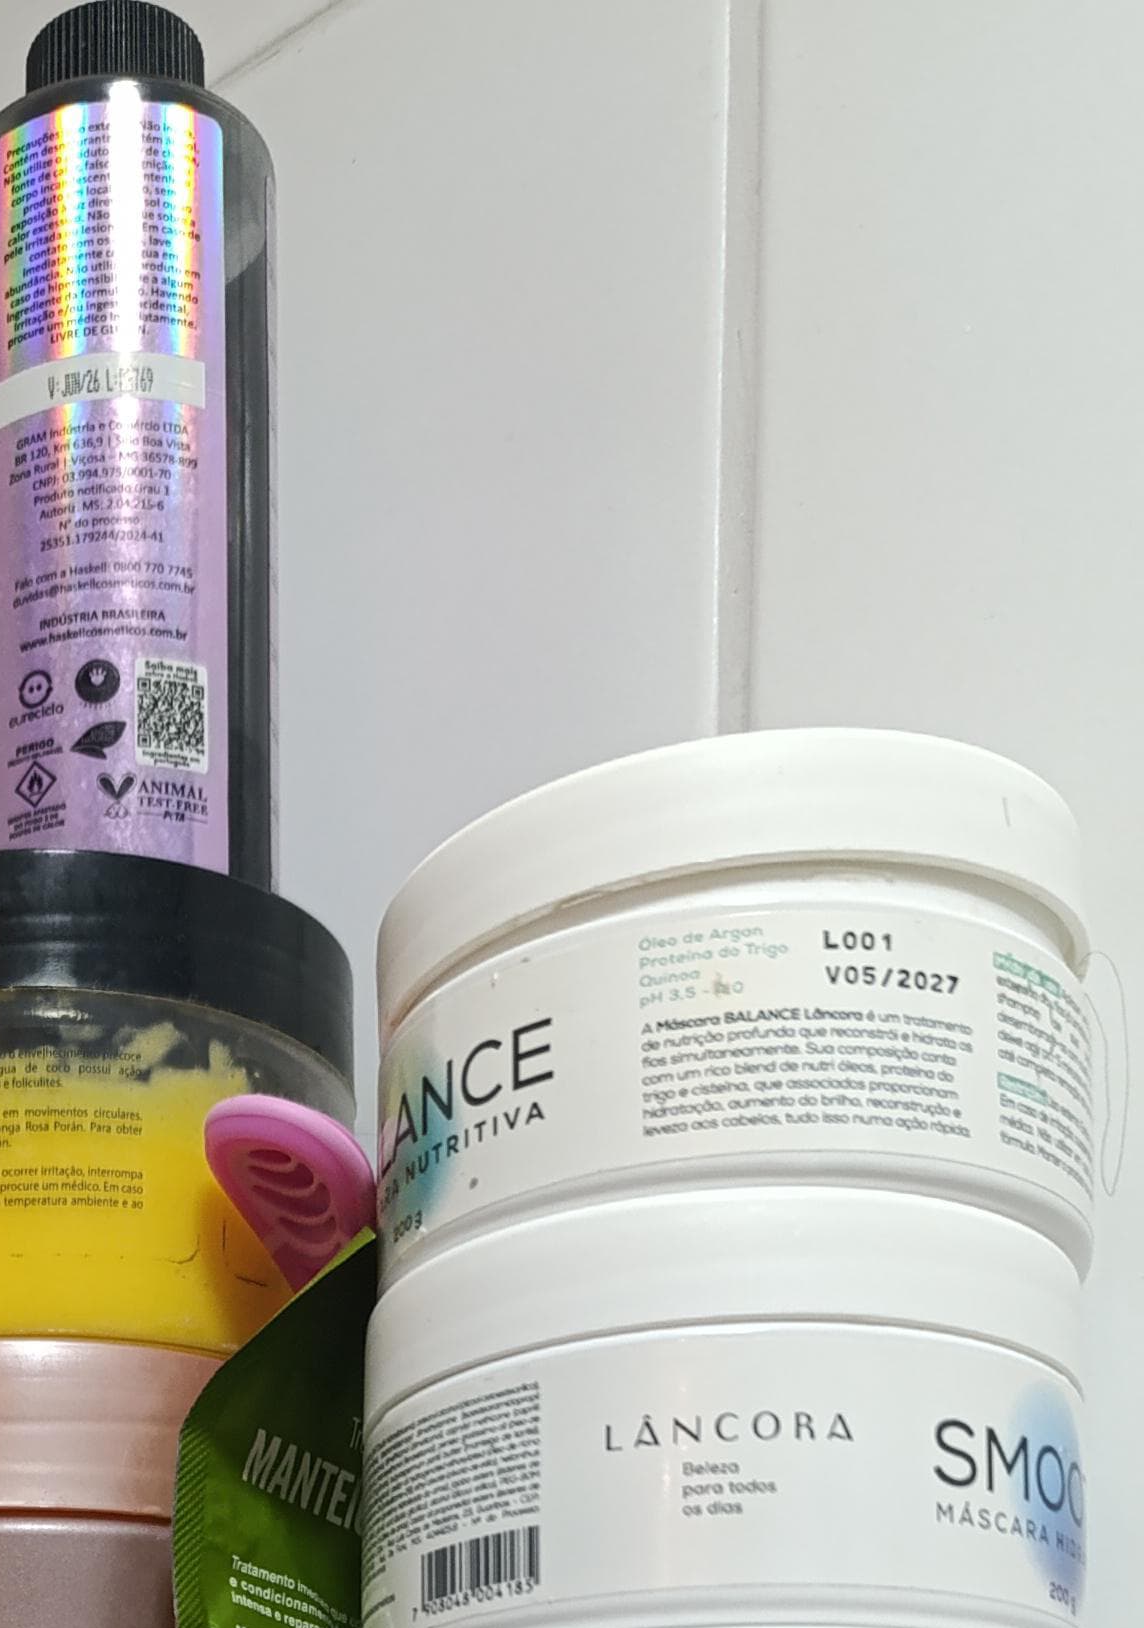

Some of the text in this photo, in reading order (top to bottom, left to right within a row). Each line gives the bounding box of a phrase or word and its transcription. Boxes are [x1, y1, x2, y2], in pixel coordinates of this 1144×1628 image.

[11, 178, 36, 195] fonte
[11, 191, 38, 208] corpo
[10, 208, 58, 234] exposição
[152, 287, 199, 304] Havendo
[8, 325, 45, 349] procure
[16, 422, 188, 451] GRAM Indústria LTDA
[30, 437, 103, 461] 120, 636,9
[8, 461, 59, 486] Zona Rural
[34, 489, 74, 507] Produto
[36, 572, 58, 585] com
[144, 563, 164, 574] 770
[168, 565, 193, 579] 7745
[39, 611, 98, 631] INDÚSTRIA
[9, 702, 64, 729] eureciclo
[139, 780, 207, 802] ANIMAL
[745, 943, 788, 958] Trigo
[822, 930, 894, 951] L001
[639, 969, 700, 987] Quinoa
[825, 965, 959, 994] V05/2027
[656, 1008, 973, 1035] Máscara BALANCE Lâncora tratamento
[664, 1025, 956, 1048] nutrição profunda que reconstrói hidrata
[642, 1041, 919, 1068] fios simultaneamente. Sua composição
[735, 1062, 776, 1074] blend
[12, 1077, 63, 1089] foliculites.
[25, 1106, 88, 1117] movimentos
[94, 1108, 142, 1120] circulares.
[26, 1123, 49, 1132] Rosa
[406, 1101, 545, 1180] NUTRITIVA
[2, 1167, 38, 1178] ocorrer
[88, 1167, 142, 1180] interrompa
[0, 1182, 39, 1193] procure
[4, 1194, 118, 1208] temperatura ambiente
[605, 1410, 854, 1452] LÂNCORA
[681, 1460, 740, 1476] Beleza
[681, 1478, 777, 1499] para todos
[681, 1500, 744, 1516] os dias
[936, 1501, 1049, 1545] MÁSCARA
[232, 1554, 295, 1589] Tratamento
